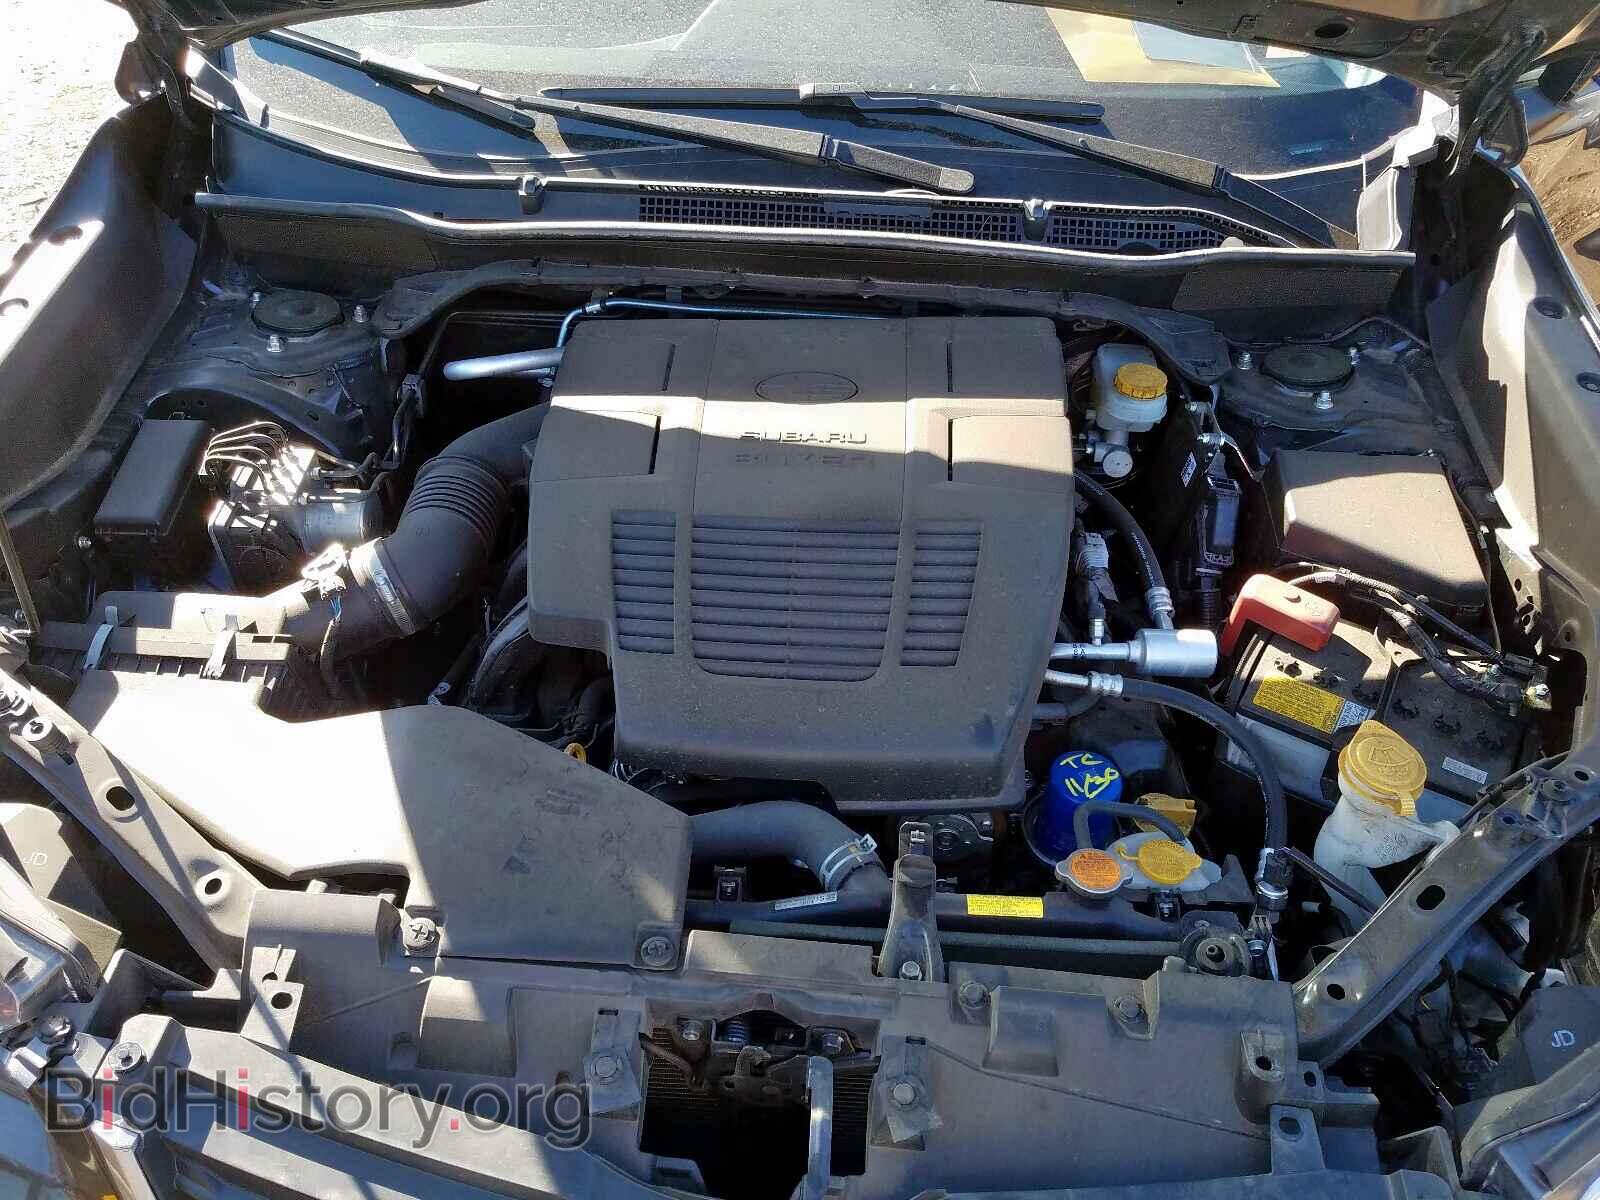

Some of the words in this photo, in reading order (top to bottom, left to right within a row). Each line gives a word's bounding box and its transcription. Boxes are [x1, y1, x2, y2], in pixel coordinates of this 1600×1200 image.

[738, 430, 868, 445] SUBARU
[1060, 753, 1104, 769] TC
[1551, 1029, 1576, 1048] JD
